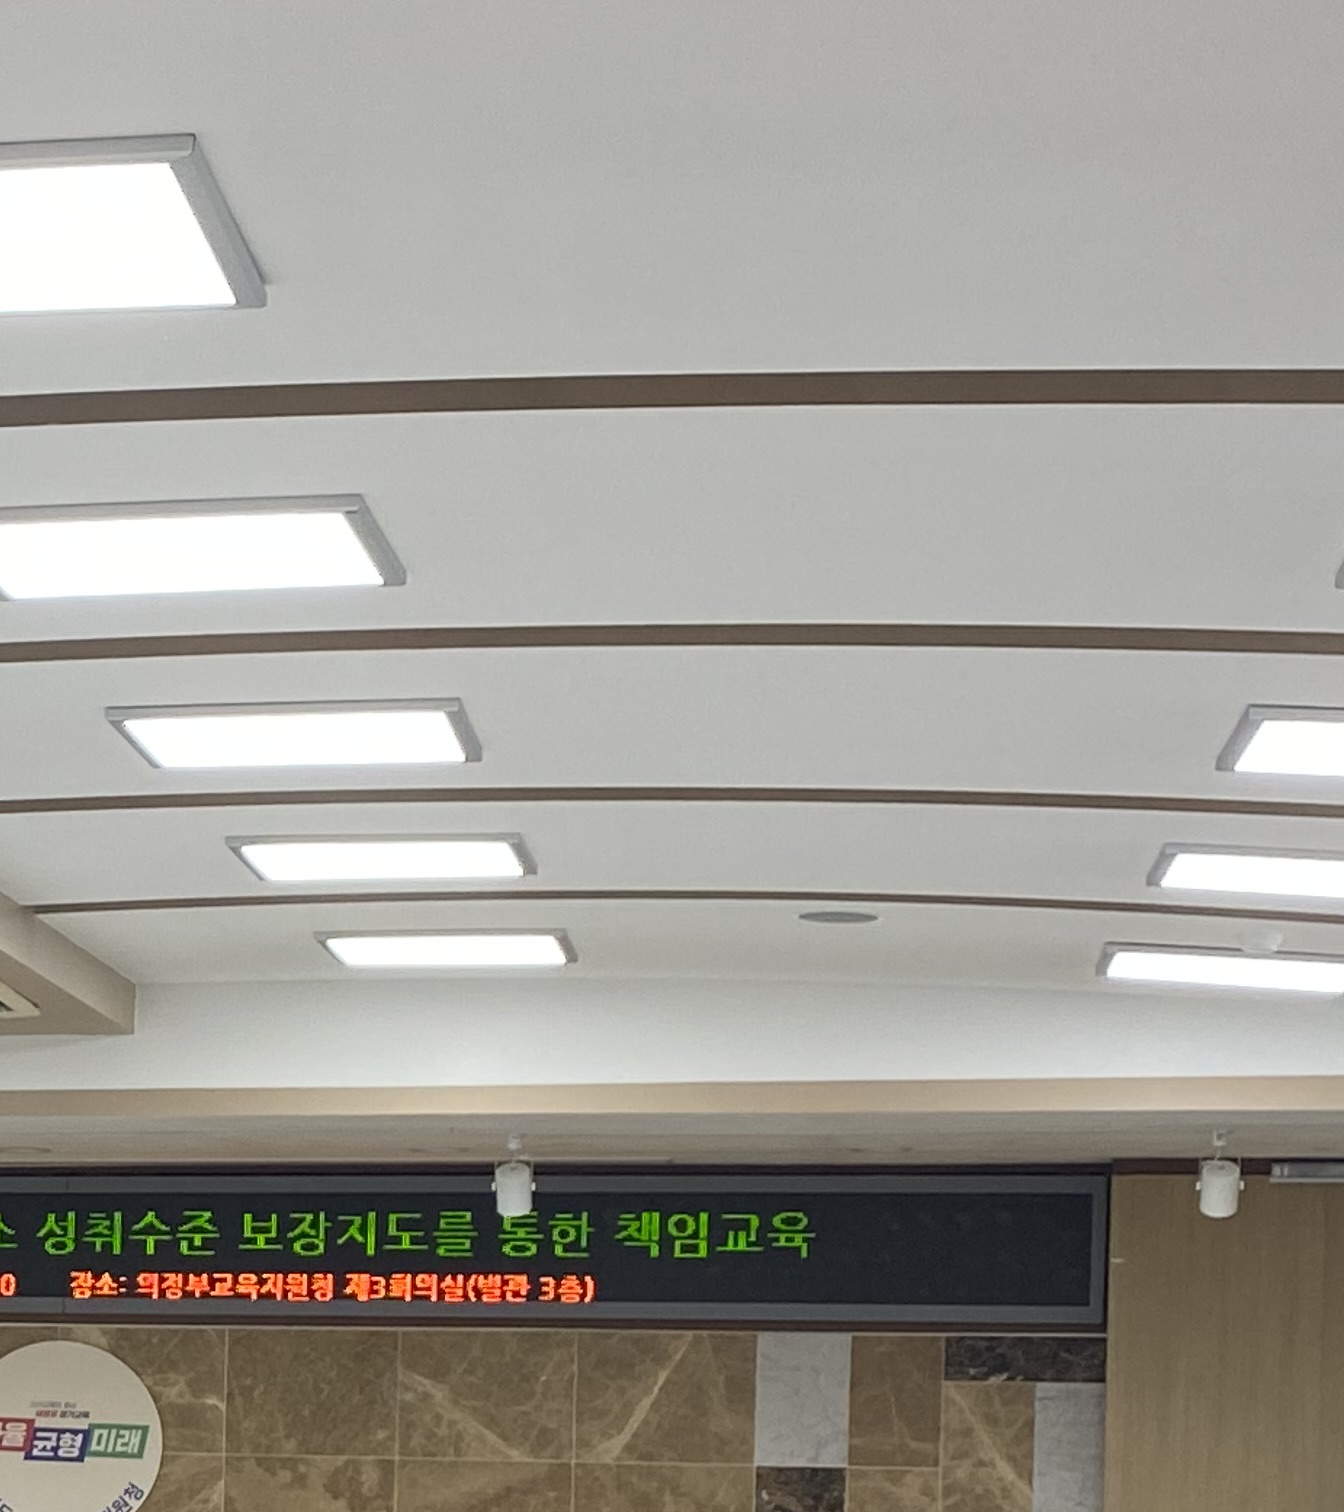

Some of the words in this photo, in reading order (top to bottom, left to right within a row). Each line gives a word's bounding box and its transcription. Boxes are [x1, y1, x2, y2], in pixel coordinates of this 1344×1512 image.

[35, 1211, 221, 1257] 성취수준
[238, 1211, 479, 1258] 보장지도를
[497, 1212, 596, 1259] 통한
[613, 1211, 817, 1260] 책임교육
[69, 1270, 128, 1300] 장소:
[135, 1271, 335, 1302] 의정부교육지원청
[538, 1273, 596, 1304] 3층)
[31, 1432, 83, 1458] 균형
[92, 1428, 141, 1454] 미래
